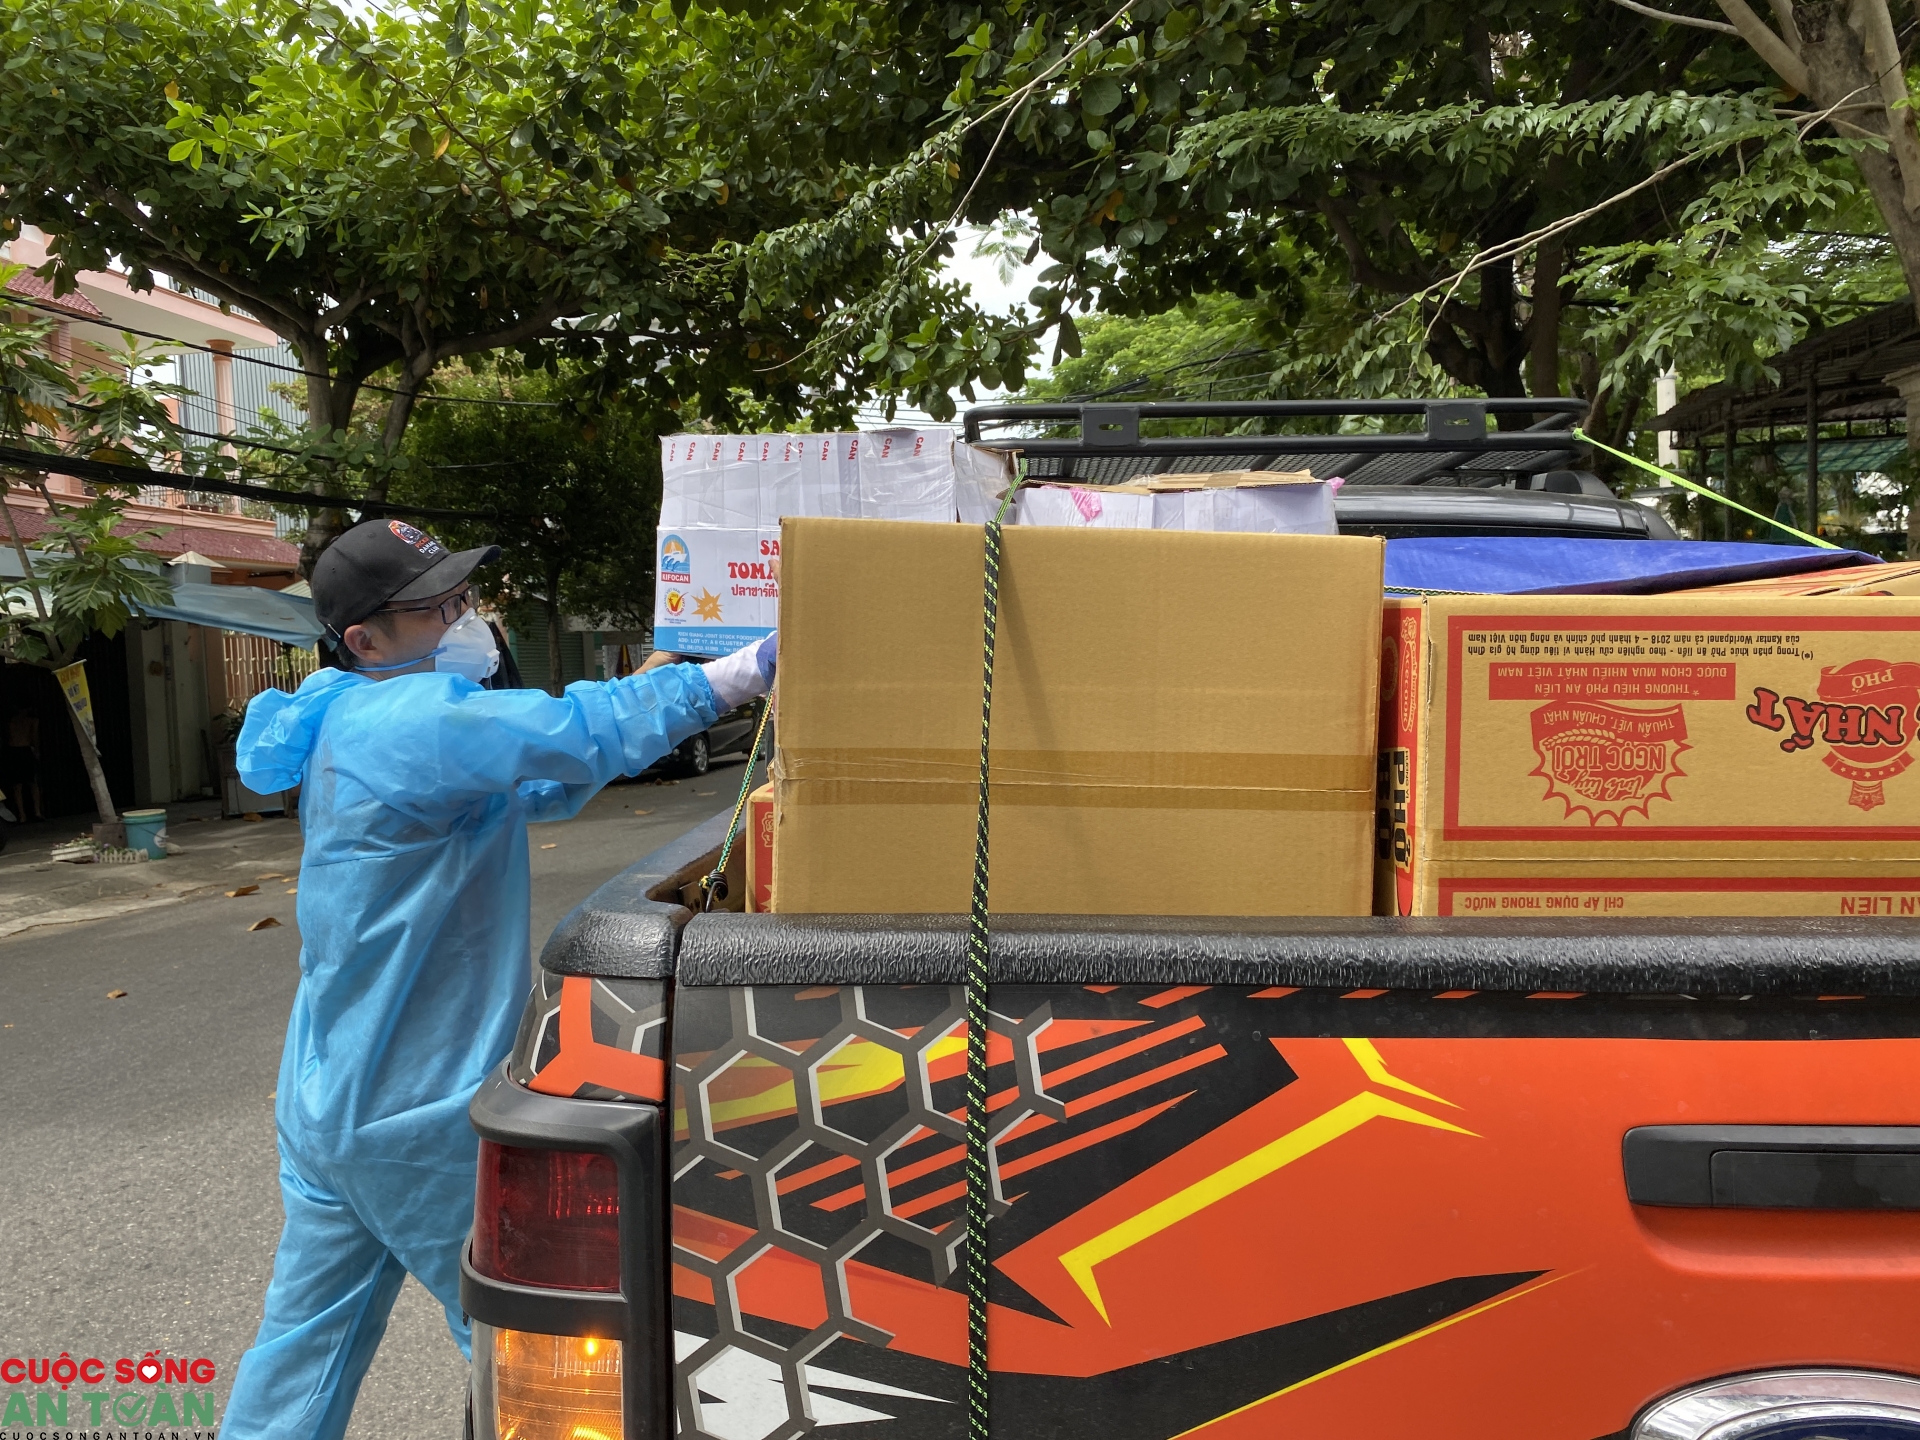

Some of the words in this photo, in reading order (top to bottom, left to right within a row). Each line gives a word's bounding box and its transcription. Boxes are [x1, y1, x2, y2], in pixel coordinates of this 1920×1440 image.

[686, 441, 696, 461] CAN
[711, 441, 722, 461] CAN
[737, 441, 746, 461] CAN
[761, 441, 770, 461] CAN
[821, 440, 830, 461] CAN
[847, 439, 859, 460] CAN
[881, 437, 893, 458] CAN
[661, 573, 690, 583] KIFOCAN
[1468, 634, 1487, 644] Nam
[1490, 633, 1506, 644] Việt
[1510, 634, 1526, 644] thôn
[1531, 632, 1550, 644] nông
[1553, 635, 1563, 644] và
[1566, 634, 1587, 644] chính
[1590, 633, 1606, 645] phố
[1609, 635, 1631, 645] thành
[1634, 635, 1640, 644] 4
[1651, 635, 1670, 645] 2018
[1674, 635, 1692, 644] năm
[1695, 635, 1704, 645] cả
[1708, 634, 1753, 645] Worldpanel
[1756, 636, 1782, 645] Kantar
[1786, 636, 1800, 645] của
[1468, 646, 1486, 656] đình
[1490, 645, 1502, 656] gia
[1506, 645, 1516, 656] hộ
[1521, 645, 1540, 656] dùng
[1544, 646, 1560, 656] tiêu
[1563, 647, 1571, 657] vi
[1575, 647, 1595, 657] Hành
[1600, 647, 1614, 657] cứu
[1618, 645, 1645, 657] nghiên
[1649, 647, 1667, 657] theo
[1678, 647, 1693, 658] liền
[1711, 647, 1726, 658] Phở
[1731, 647, 1749, 657] khúc
[1753, 645, 1773, 657] phân
[1776, 645, 1800, 657] Trong
[1498, 668, 1523, 677] NAM
[1528, 667, 1553, 680] VIỆT
[1558, 668, 1588, 682] NHẤT
[1593, 668, 1628, 682] NHIỀU
[1631, 667, 1657, 678] MUA
[1661, 666, 1692, 678] CHỌN
[1693, 666, 1727, 677] ĐƯỢC
[1534, 684, 1561, 698] LIỀN
[1586, 684, 1609, 696] PHỞ
[1613, 682, 1640, 696] HIỆU
[1745, 686, 1905, 754] NHẤT
[1637, 718, 1675, 739] THUẦN
[1605, 741, 1664, 772] NGỌC
[1569, 769, 1604, 801] túy
[1604, 775, 1645, 801] Tinh
[1464, 897, 1497, 911] NƯỚC
[1502, 897, 1541, 909] TRONG
[1546, 895, 1579, 909] DỤNG
[1583, 897, 1600, 911] ÁP
[1604, 897, 1624, 912] CHỈ
